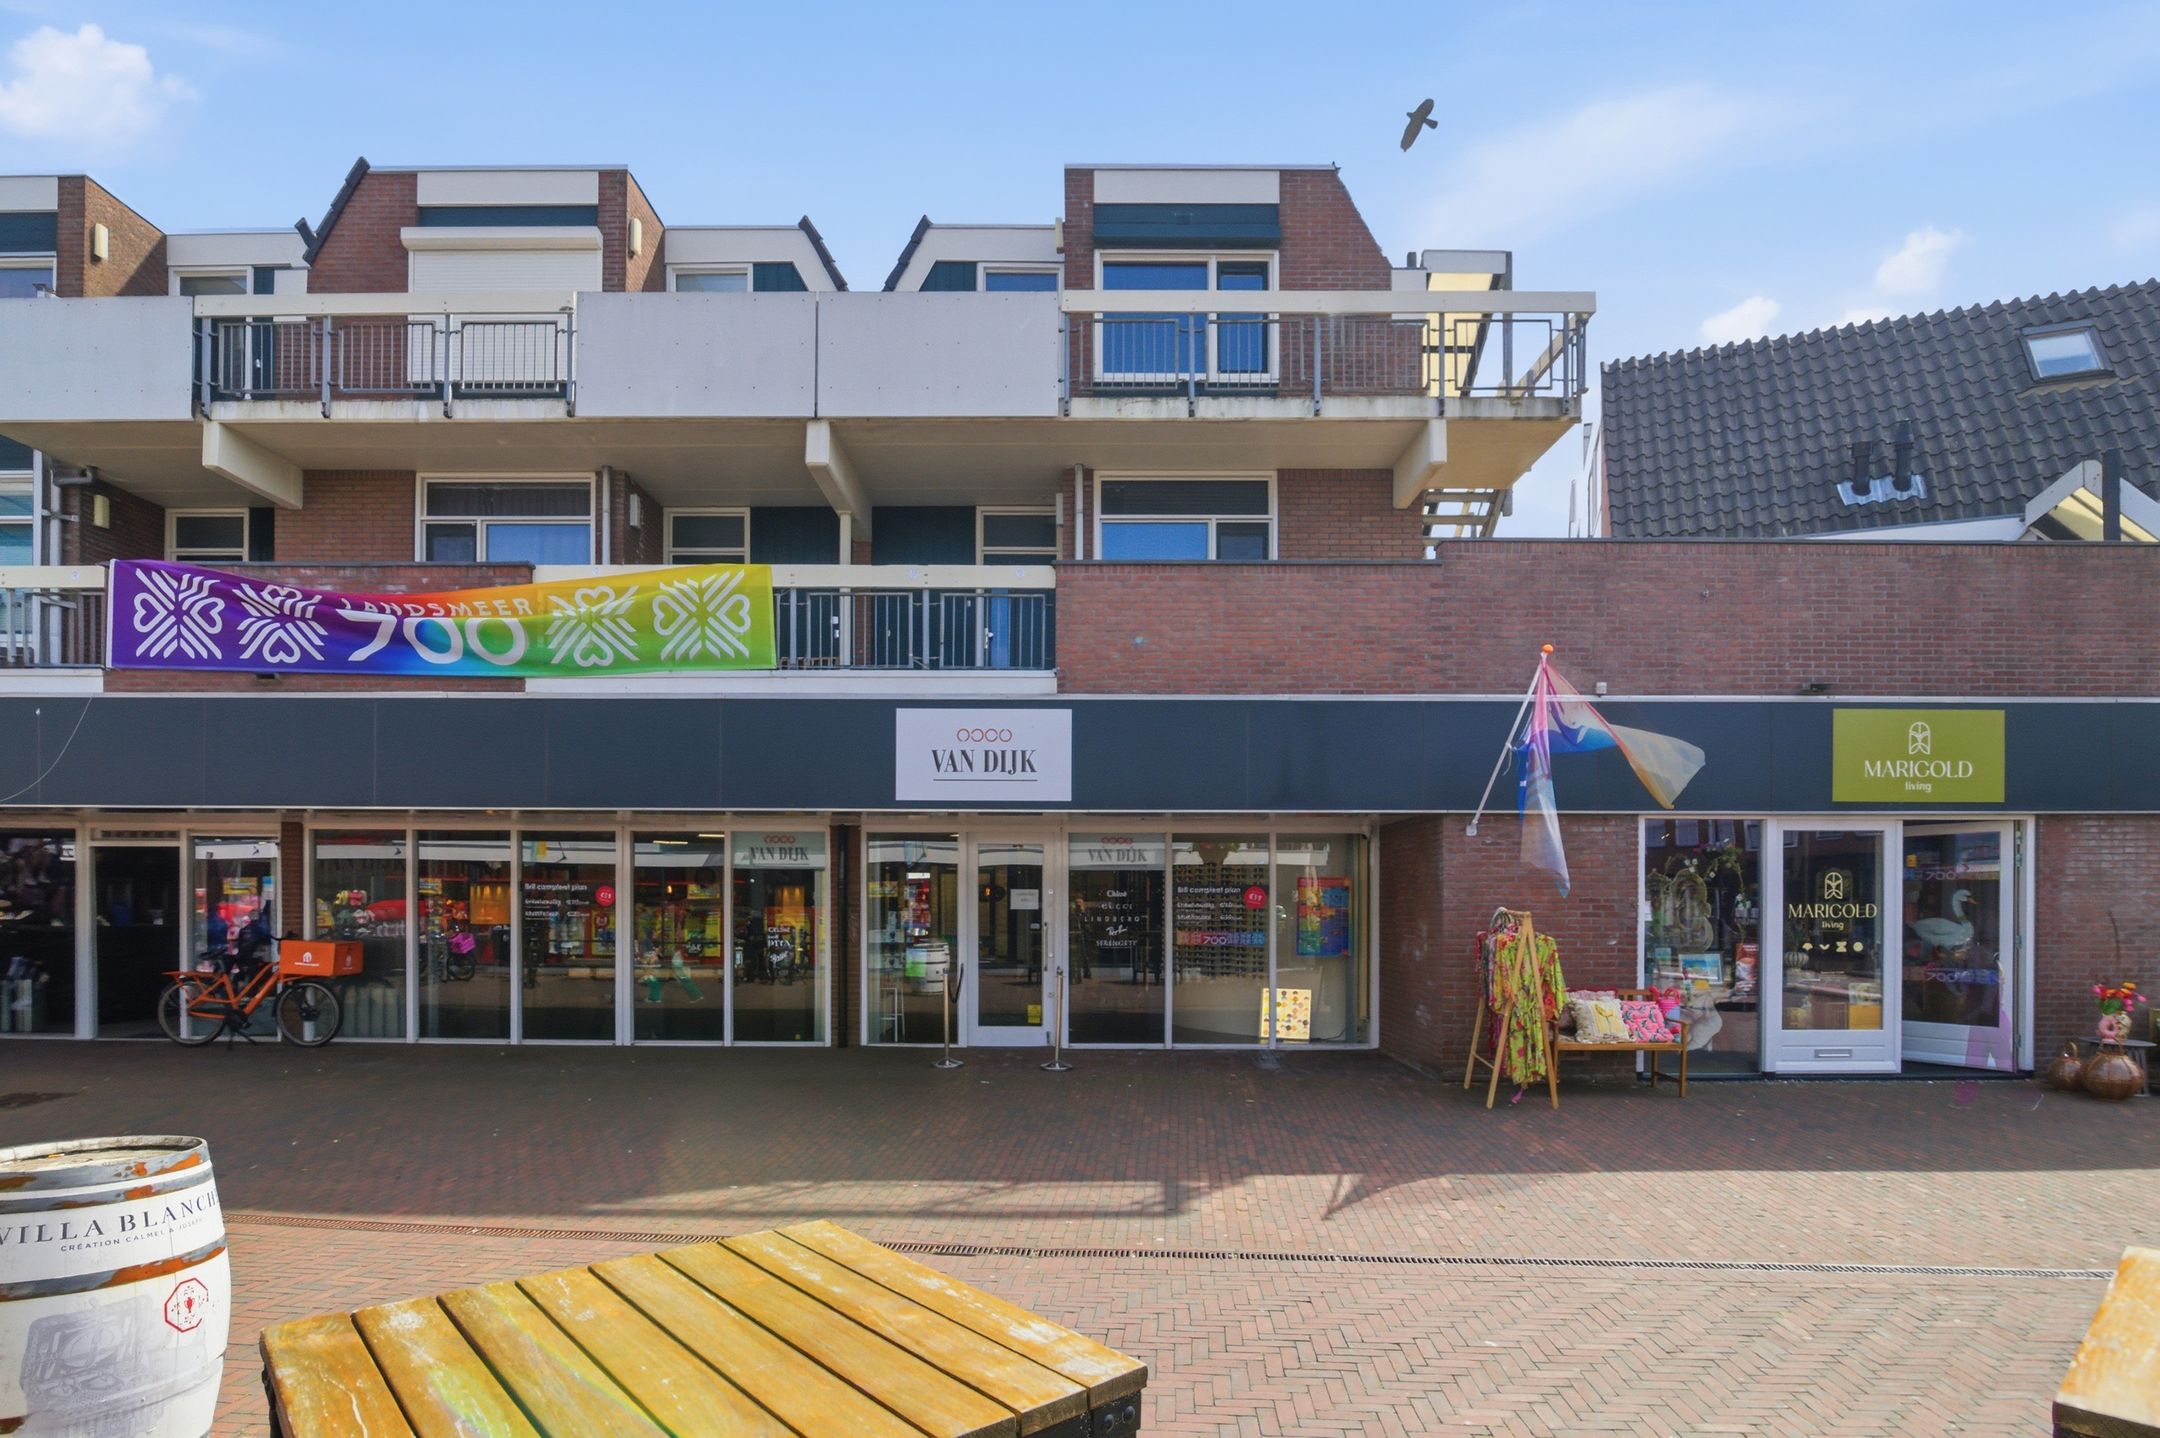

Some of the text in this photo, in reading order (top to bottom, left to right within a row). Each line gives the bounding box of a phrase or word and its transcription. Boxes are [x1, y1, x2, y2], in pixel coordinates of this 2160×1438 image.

[335, 609, 528, 666] 700
[931, 749, 1038, 775] VAN DIJK
[1864, 760, 1973, 778] MARIGOLD
[1905, 781, 1932, 792] living
[750, 847, 809, 861] VAN DIJK
[1088, 849, 1113, 862] VAN
[1788, 903, 1877, 918] MARIGOLD
[1822, 921, 1844, 930] living
[1202, 935, 1227, 945] 700
[0, 1219, 105, 1246] VILLA
[60, 1238, 120, 1252] CRÉATION
[125, 1230, 164, 1243] CALMEL
